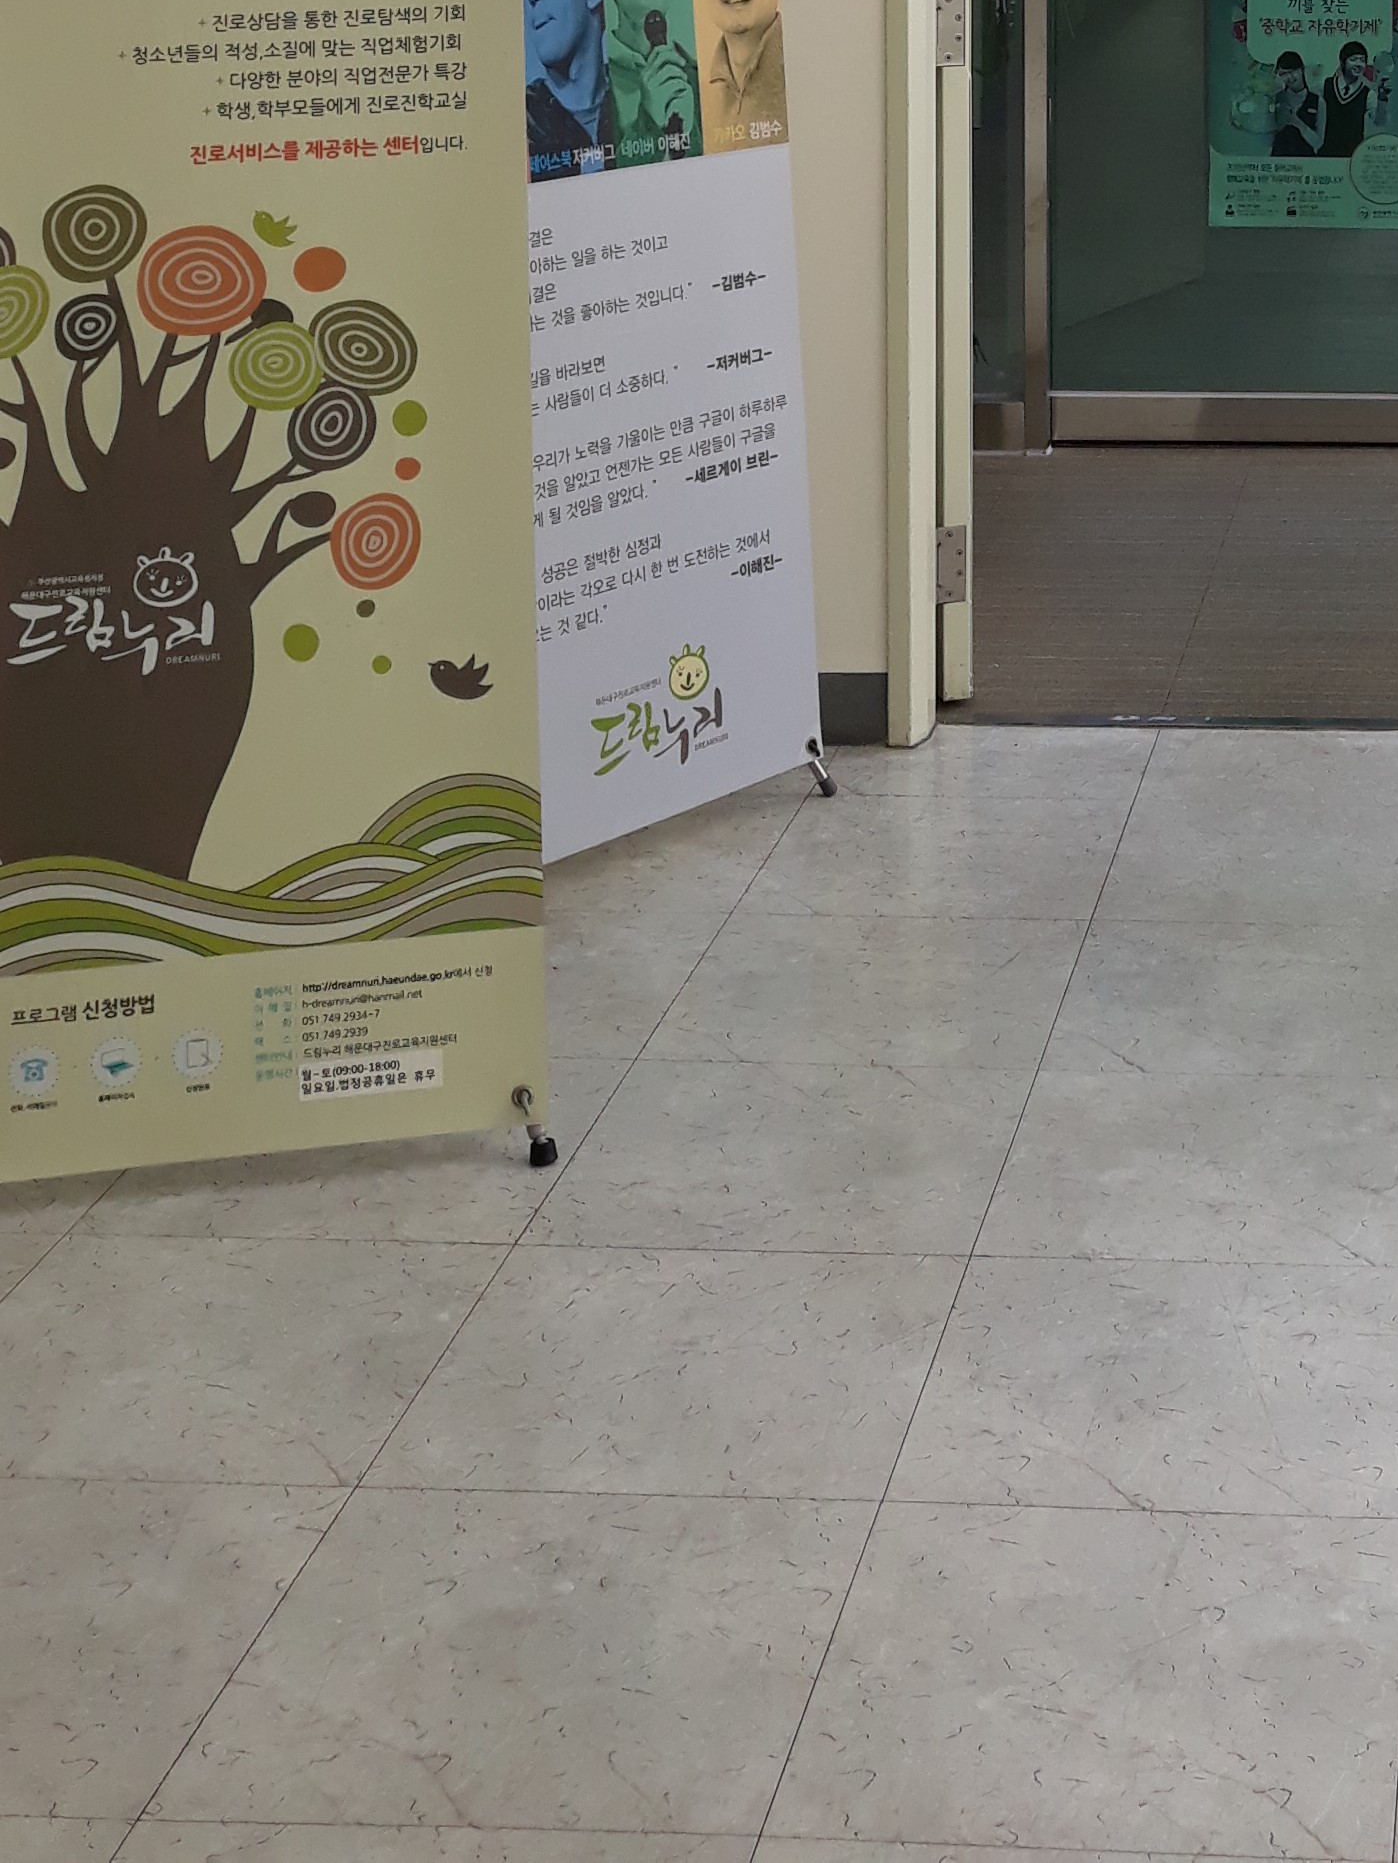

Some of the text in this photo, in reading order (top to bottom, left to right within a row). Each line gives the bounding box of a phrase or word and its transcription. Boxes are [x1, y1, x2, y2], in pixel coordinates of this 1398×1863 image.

[212, 4, 467, 33] 진로상담을 통한 진로탐색의 기회
[132, 33, 462, 65] 청소년들의 맞는 직업체험기회
[229, 61, 467, 90] 다양한 분야의 직업전문가 특강
[366, 91, 467, 115] 진로진학교실
[190, 137, 379, 165] 진로서비스를 제공하는
[573, 144, 616, 166] 저커버그
[621, 138, 654, 159] 네이버
[658, 134, 691, 152] 이해진
[749, 120, 783, 139] 김범수
[571, 247, 597, 268] 일을
[600, 241, 626, 261] 하는
[630, 235, 669, 257] 것이고
[551, 297, 630, 327] 것을 좋아하는
[555, 355, 606, 382] 바라보면
[545, 385, 595, 412] 사람들이
[600, 382, 612, 398] 더
[533, 394, 788, 471] 우리가 노력을 기울이는 만큼 구글이 하루하루
[534, 480, 559, 501] 것을
[658, 446, 683, 466] 모든
[688, 433, 736, 459] 사람들이
[740, 422, 776, 444] 구글을
[566, 495, 603, 520] 것임을
[541, 533, 662, 584] 성공은 절박한 심정과
[580, 528, 771, 598] 각오로 다시 한 번 도전하는 것에서
[6, 595, 215, 676] 드림누리
[557, 617, 570, 636] 것
[591, 687, 723, 776] 드림누리
[11, 994, 155, 1025] 프로그램 신청방법
